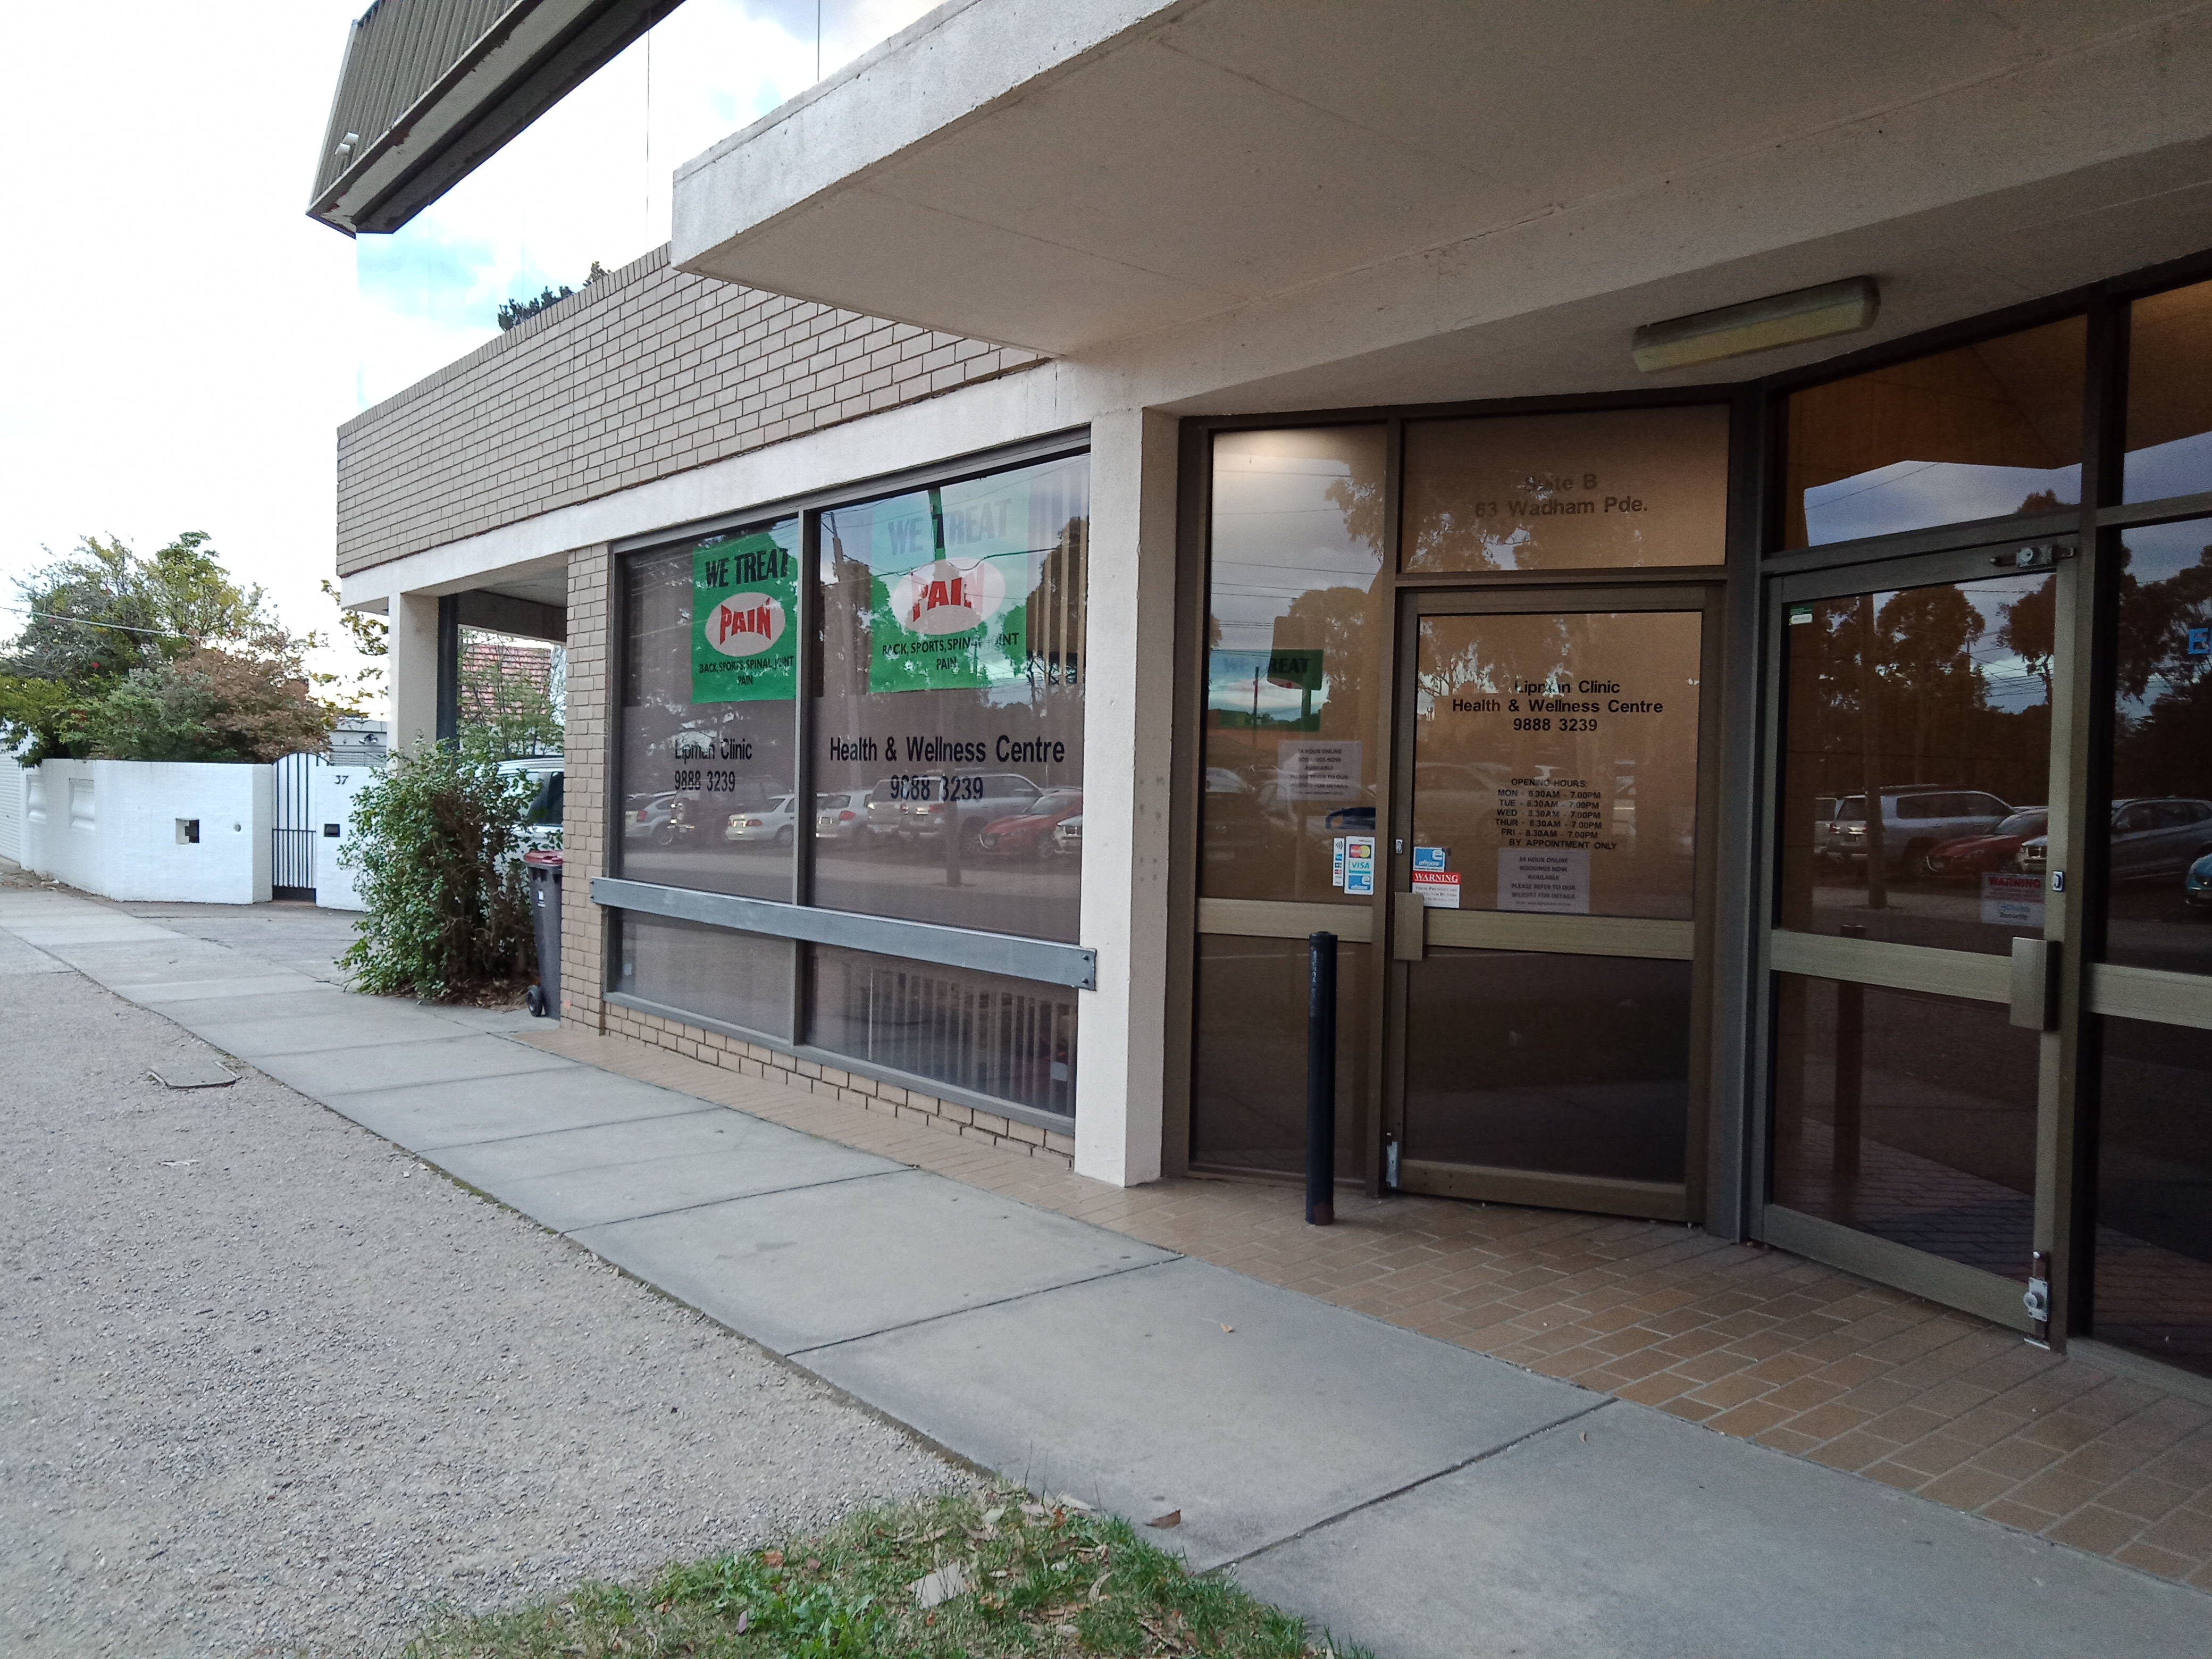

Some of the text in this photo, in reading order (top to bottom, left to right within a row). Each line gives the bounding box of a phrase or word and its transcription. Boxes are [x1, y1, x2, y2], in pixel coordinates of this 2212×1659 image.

[1525, 473, 1597, 491] Site B
[1474, 495, 1647, 518] 63 Wadham Pde.
[888, 498, 1012, 556] WE TREAT
[705, 548, 789, 589] WE TREAT
[911, 563, 985, 623] PAIN
[720, 597, 771, 645] PAIN
[2188, 627, 2212, 655] E
[936, 657, 958, 671] PAIN
[737, 675, 753, 685] PAIN
[1578, 680, 1620, 694] Clinic
[1452, 699, 1663, 713] Health & Wellness Centre
[1513, 718, 1598, 732] 9888 3239
[675, 738, 752, 765] Lipman Clinic
[830, 734, 1065, 763] Health & Wellness Centre
[334, 775, 349, 785] 37
[675, 770, 735, 792] 9888 3239
[891, 775, 983, 801] 9888 3239
[1528, 790, 1560, 798] 8.30AM
[1570, 811, 1601, 819] 7.00PM
[1526, 840, 1590, 849] APPOINTMENT
[1414, 873, 1459, 883] WARNING
[1989, 877, 2041, 889] WARNING
